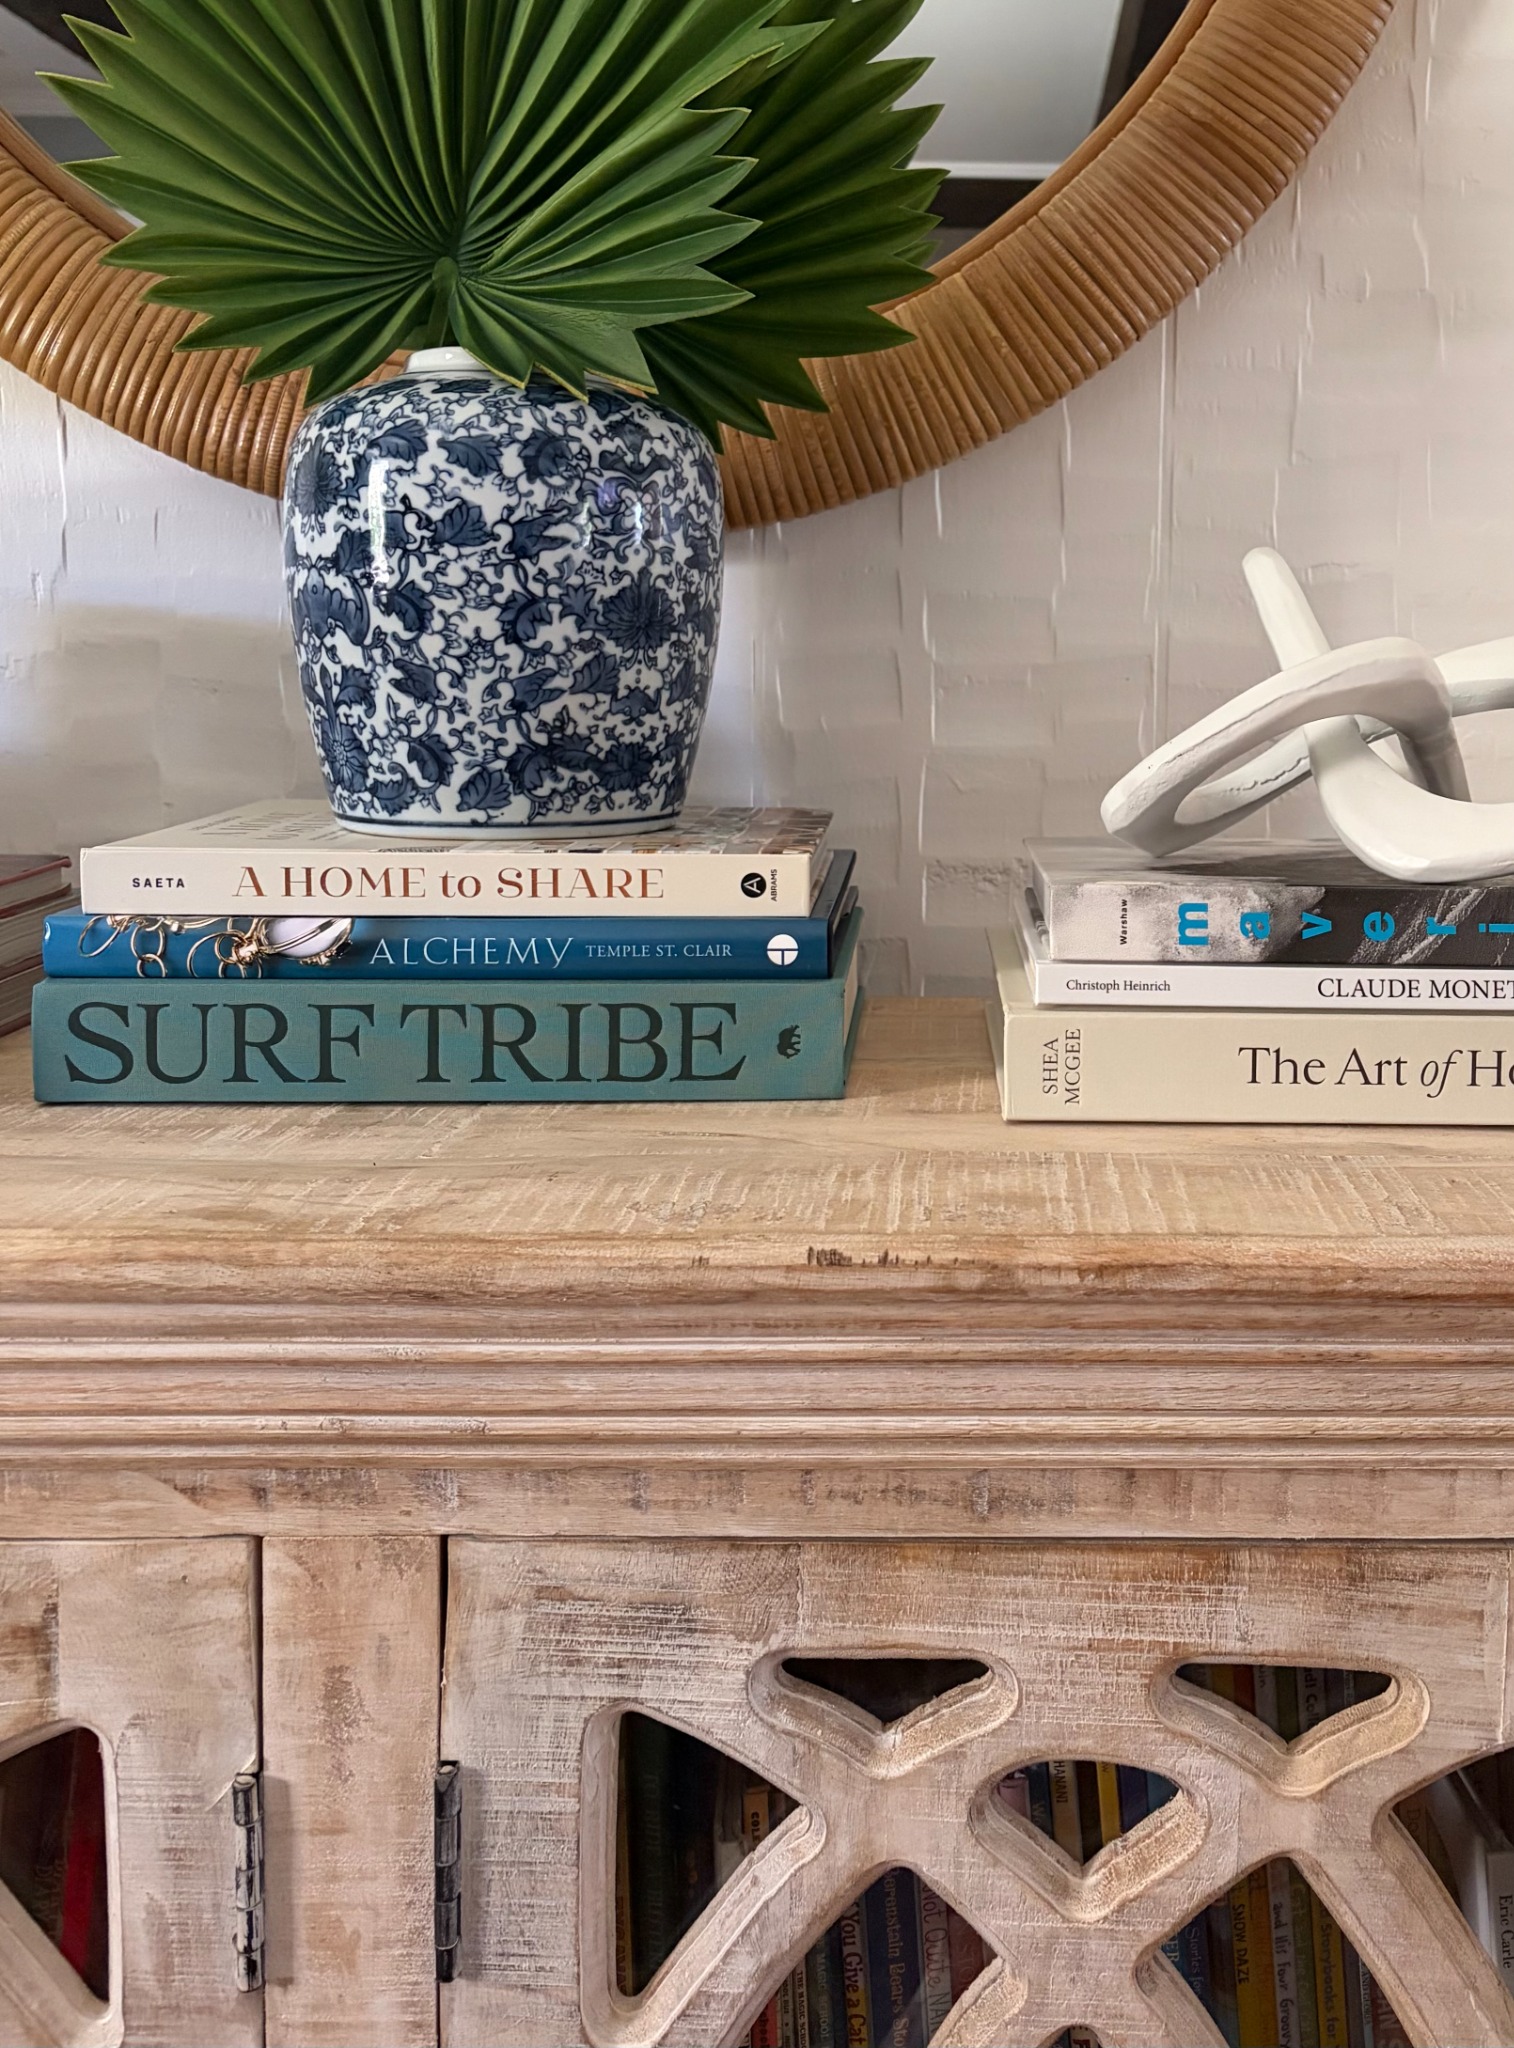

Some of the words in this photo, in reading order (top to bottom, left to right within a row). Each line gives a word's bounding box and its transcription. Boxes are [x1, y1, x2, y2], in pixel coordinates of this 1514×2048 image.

[132, 877, 185, 888] SAETA
[232, 866, 268, 897] A
[281, 866, 426, 898] HOME
[439, 868, 482, 898] to
[497, 866, 665, 899] SHARE
[770, 868, 778, 902] ABRAMS
[1118, 898, 1128, 946] Warshaw
[369, 936, 574, 968] ALCHEMY
[585, 943, 650, 958] TEMPLE
[656, 943, 679, 958] ST.
[683, 943, 732, 958] CLAIR
[1066, 978, 1120, 995] Christoph
[1123, 978, 1171, 993] Heinrich
[1317, 978, 1421, 999] CLAUDE
[64, 1001, 375, 1085] SURF
[400, 1001, 747, 1084] TRIBE
[1042, 1037, 1059, 1095] SHEA
[1064, 1028, 1081, 1105] MCGEE
[1238, 1046, 1326, 1086] The
[1334, 1046, 1409, 1086] Art
[1420, 1049, 1463, 1098] of
[1467, 1049, 1514, 1087] H
[1231, 1903, 1246, 1943] SNOW
[1272, 1902, 1288, 1929] and
[1499, 1894, 1513, 1926] Eric
[842, 1911, 860, 1946] You
[924, 1928, 951, 1989] Quite
[1185, 1926, 1202, 1975] Stories
[1235, 1947, 1250, 1985] DAZE
[1500, 1930, 1514, 1969] Carle
[796, 1970, 804, 1990] THE
[844, 1952, 864, 1993] Give
[1321, 1923, 1337, 2013] Storybooks
[797, 1991, 806, 2020] MAGIC
[846, 1994, 861, 2009] a
[889, 1963, 906, 2014] Bears
[847, 2013, 867, 2047] Cat
